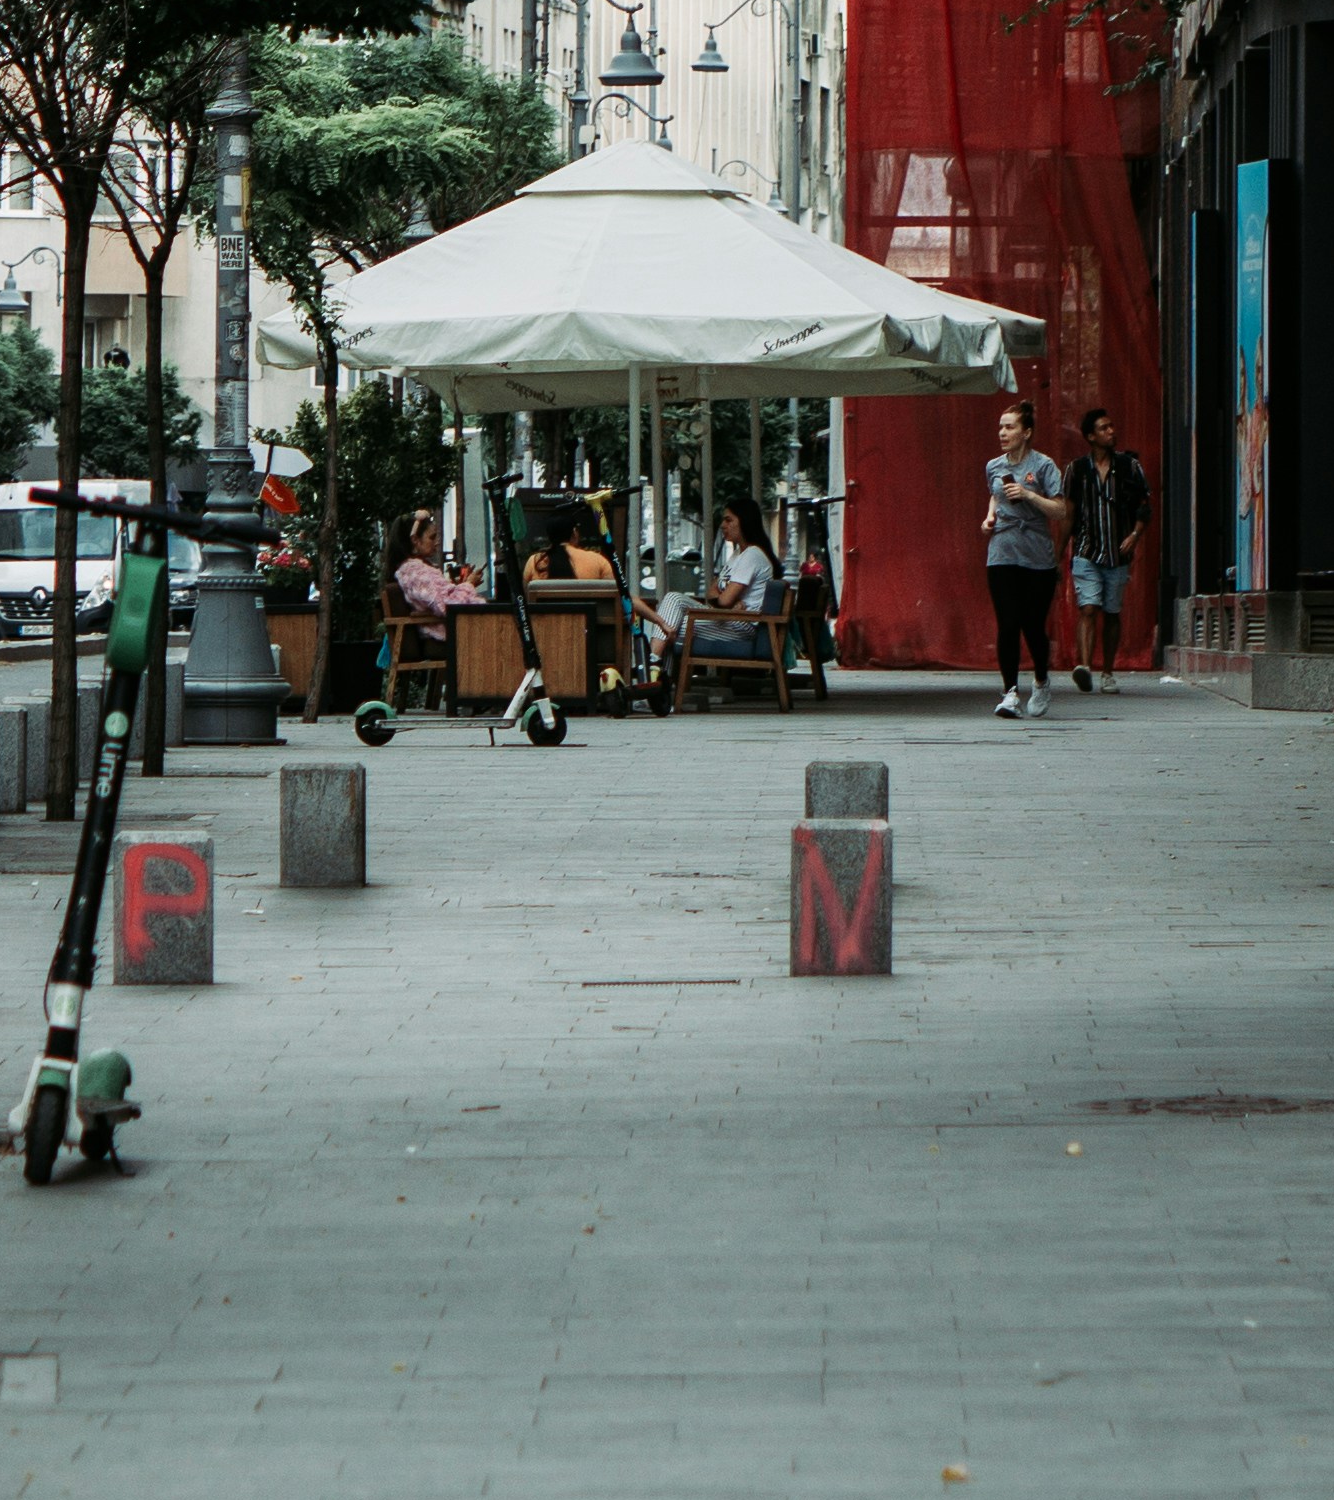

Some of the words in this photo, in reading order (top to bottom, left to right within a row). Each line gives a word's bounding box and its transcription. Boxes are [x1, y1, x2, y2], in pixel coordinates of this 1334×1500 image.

[221, 237, 244, 251] BNE
[762, 320, 825, 355] Schweppes
[121, 842, 209, 966] P
